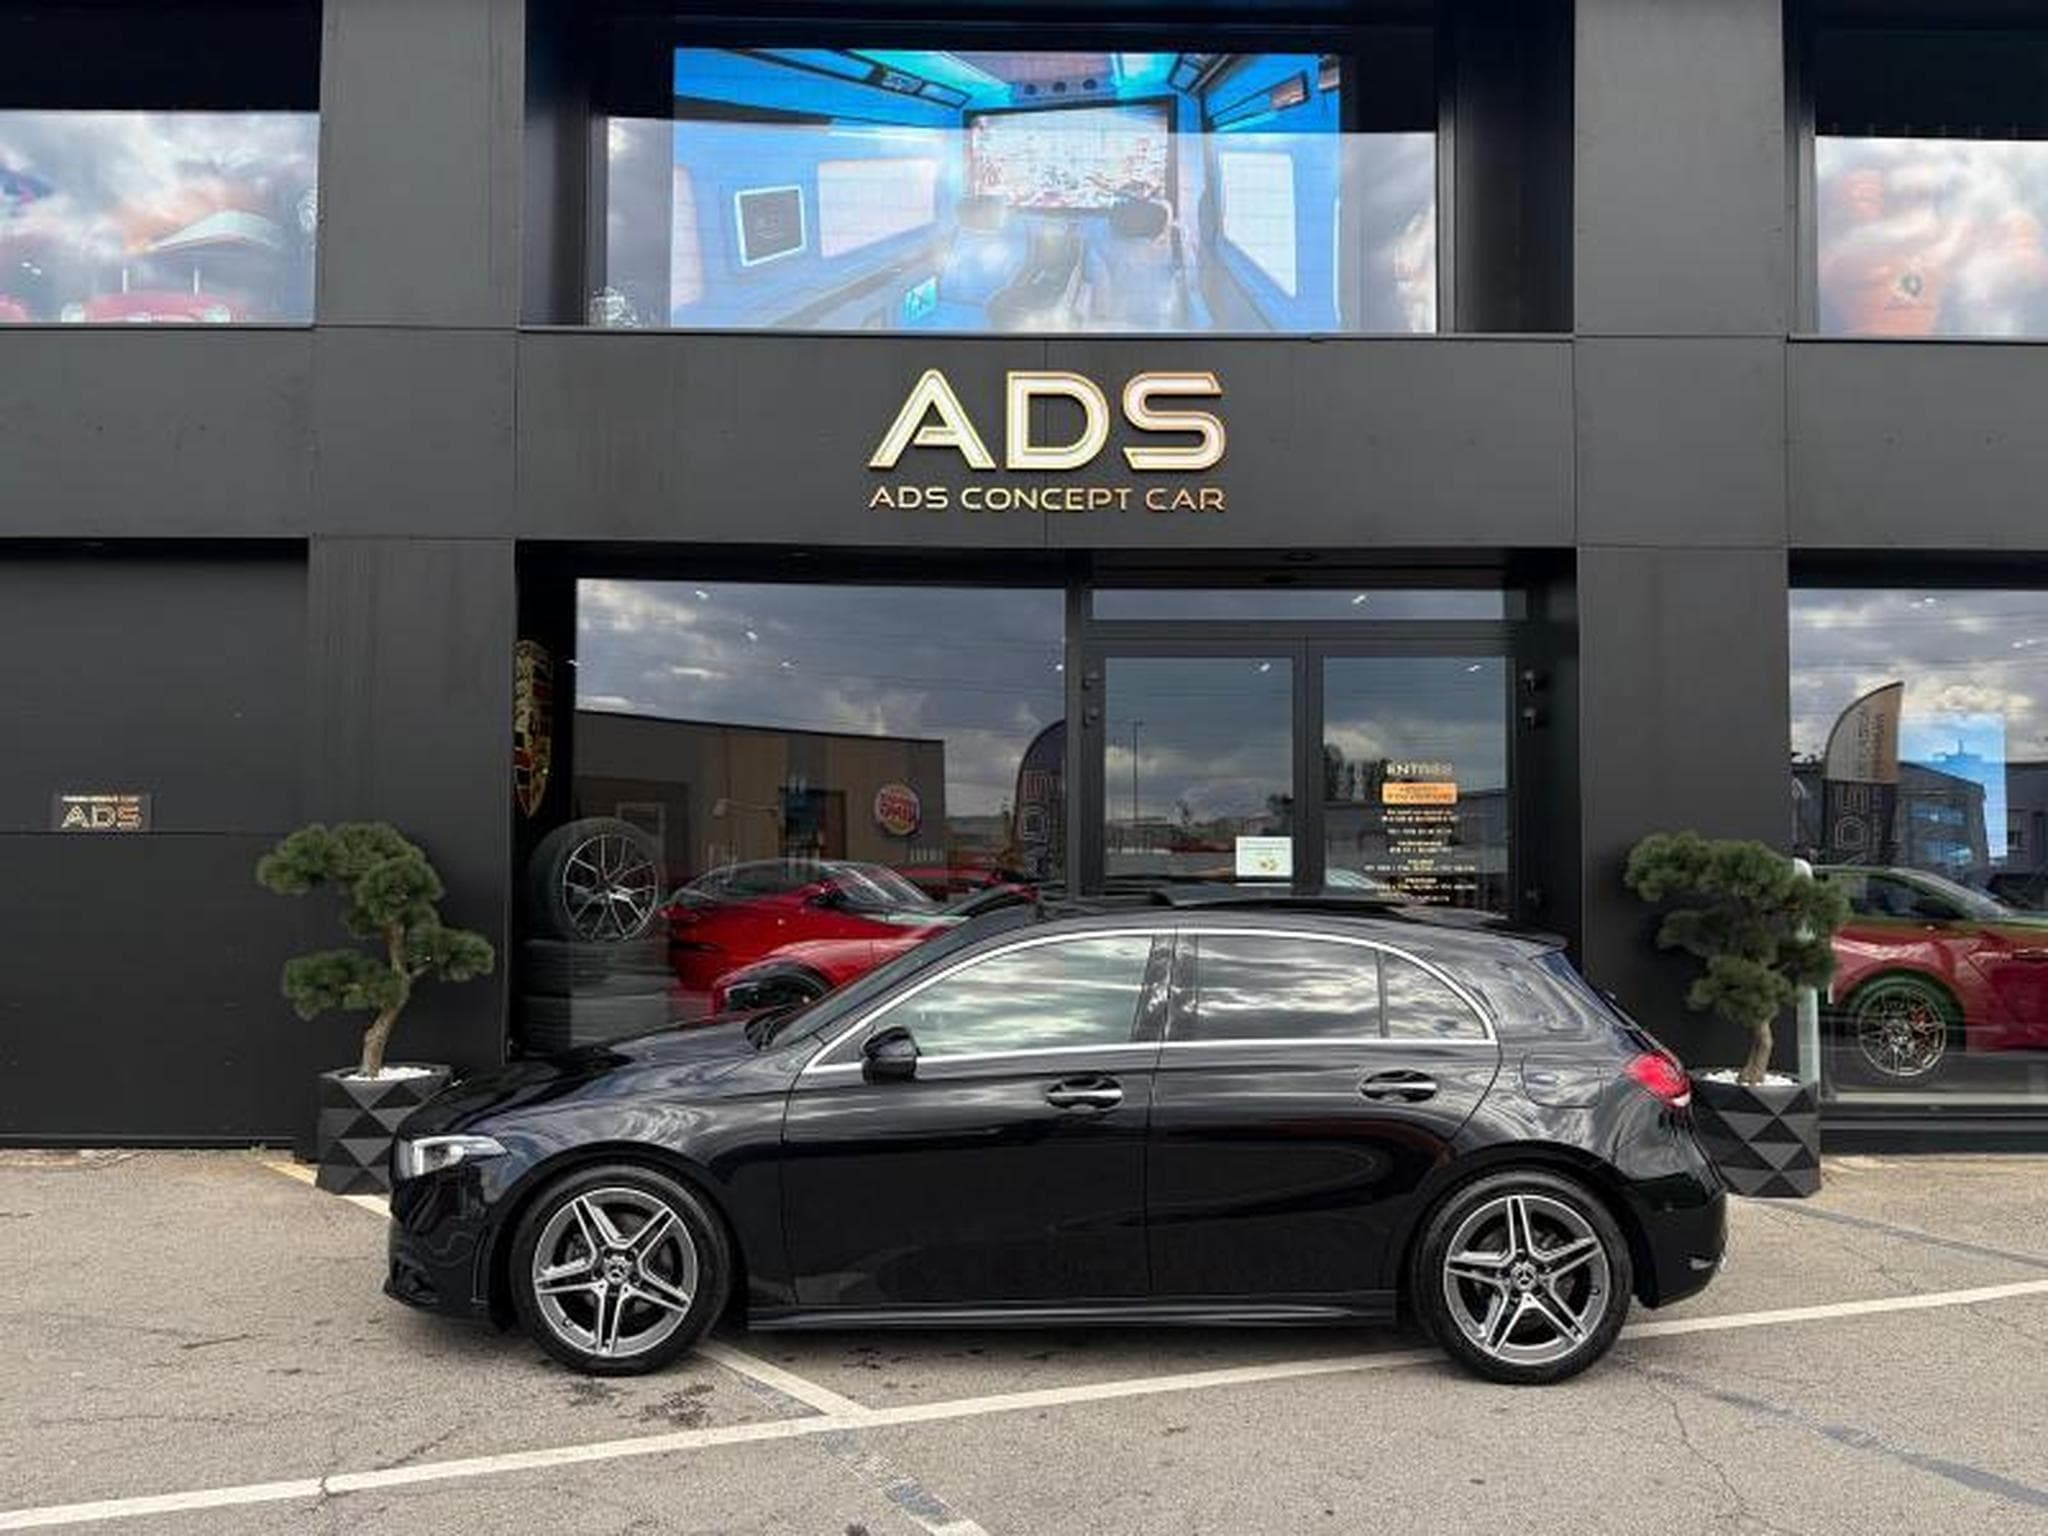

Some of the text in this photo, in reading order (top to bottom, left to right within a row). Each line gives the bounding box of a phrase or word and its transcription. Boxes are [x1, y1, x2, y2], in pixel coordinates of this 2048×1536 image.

[868, 368, 1226, 471] ADS
[868, 486, 1226, 513] ADS CONCEPT CAR
[61, 805, 142, 828] ADS
